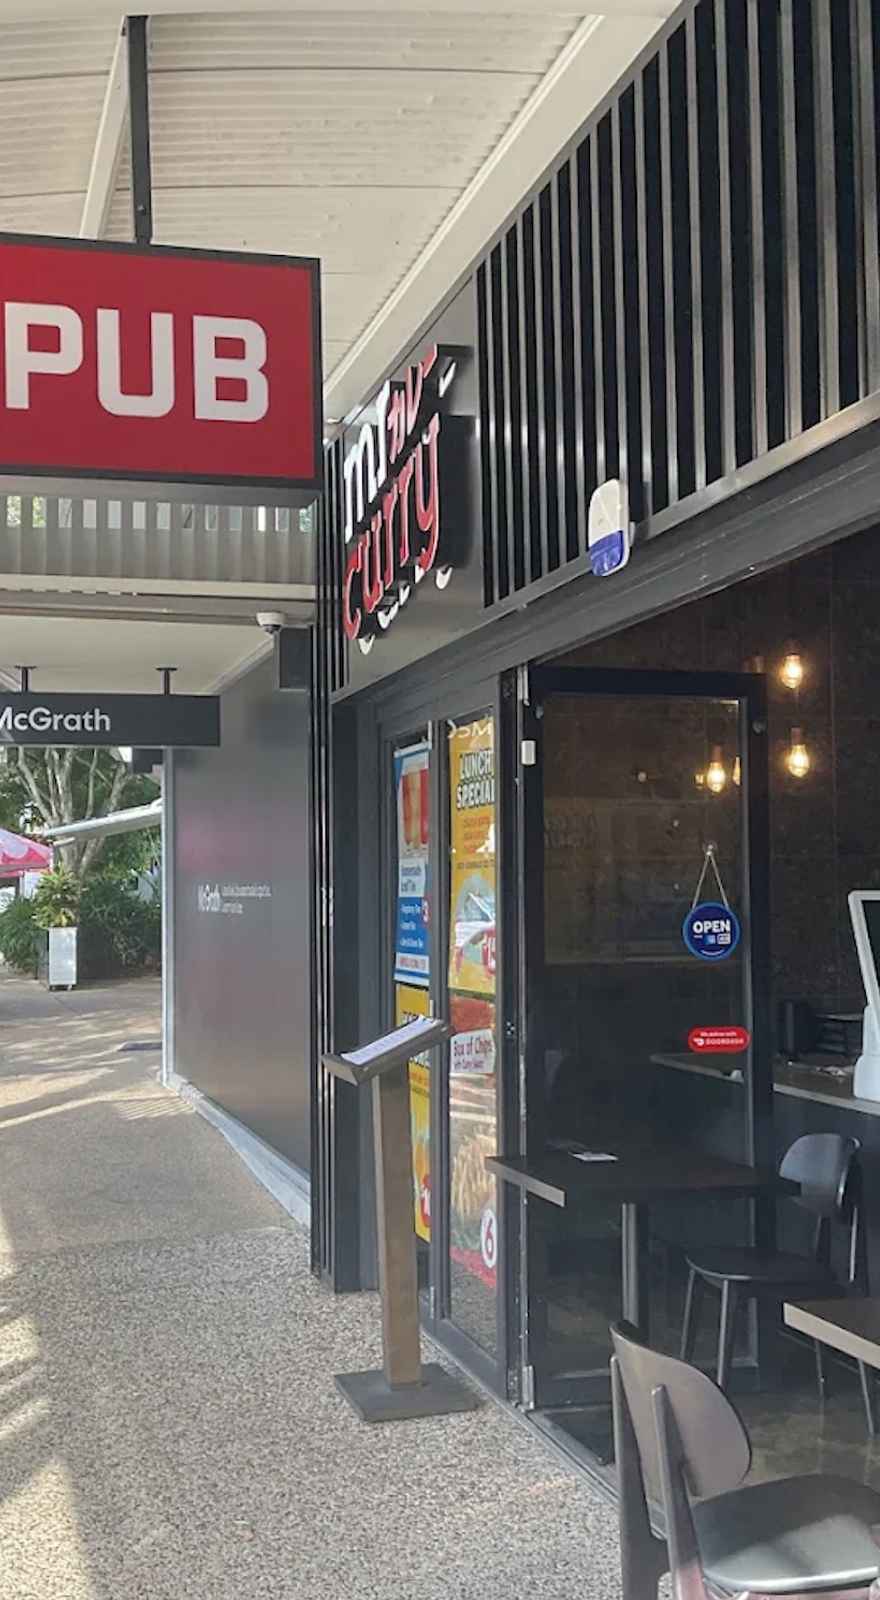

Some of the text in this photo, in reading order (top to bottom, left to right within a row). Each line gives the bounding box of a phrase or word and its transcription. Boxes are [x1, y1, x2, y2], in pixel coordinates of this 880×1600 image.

[4, 301, 269, 423] PUB
[343, 379, 391, 544] mr
[343, 412, 440, 640] curry
[0, 706, 111, 731] McGrath
[692, 919, 731, 934] OPEN
[485, 1217, 494, 1260] 6
